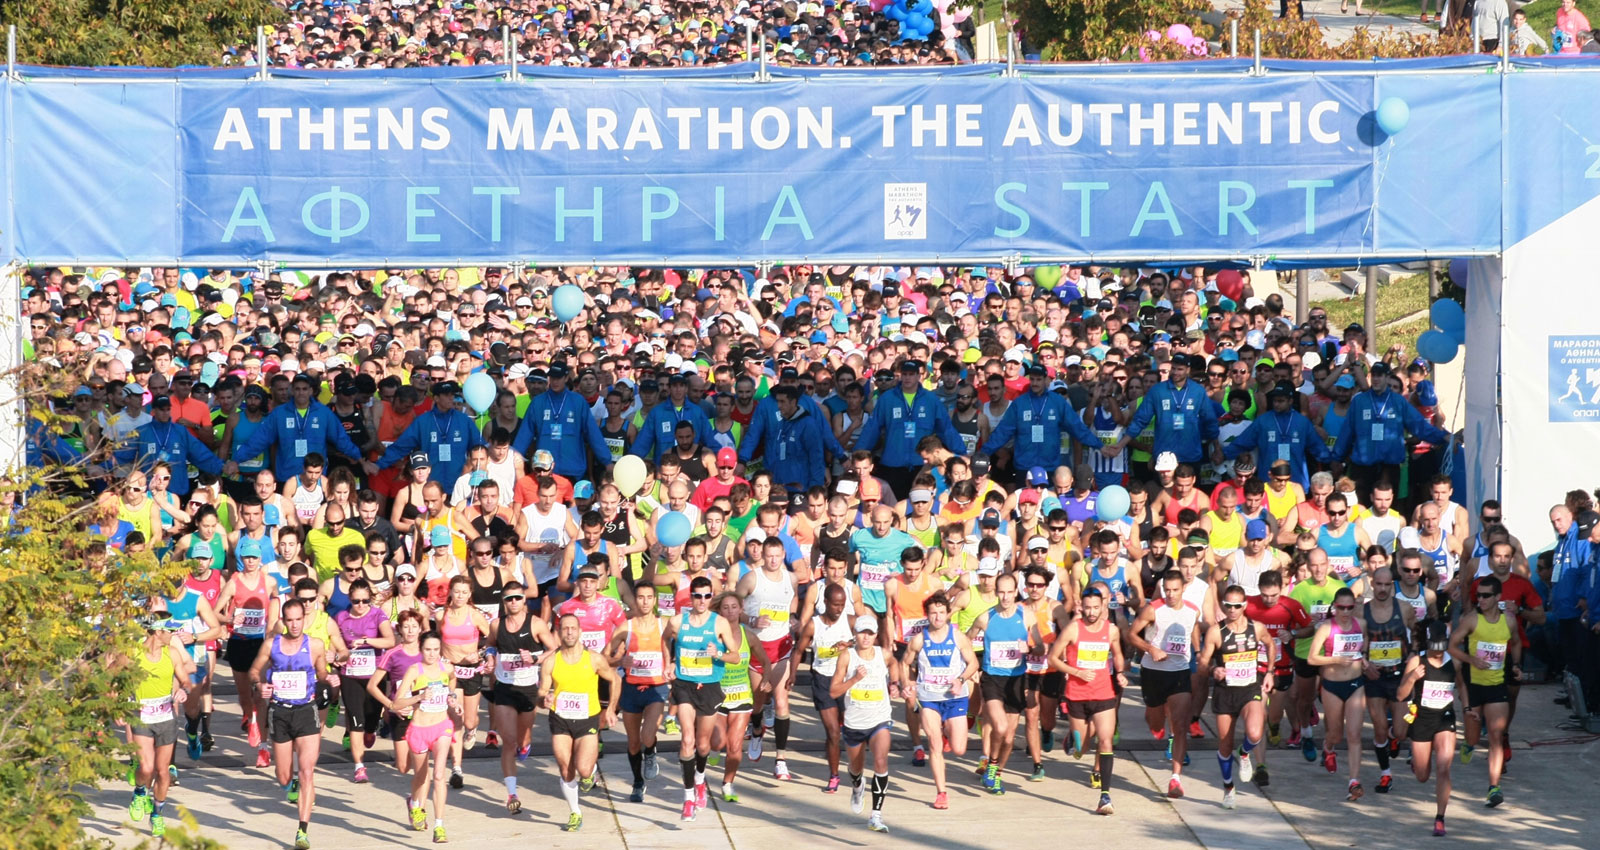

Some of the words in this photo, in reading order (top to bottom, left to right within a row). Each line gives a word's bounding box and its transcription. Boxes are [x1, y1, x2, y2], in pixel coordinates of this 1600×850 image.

[214, 107, 450, 151] ATHENS
[487, 107, 852, 150] MARATHON.
[872, 104, 983, 147] THE
[1003, 99, 1340, 147] AUTHENTIC
[994, 179, 1335, 237] START
[222, 185, 814, 243] ΑΦΕΤΗΡΙΑ
[867, 572, 882, 580] 322
[1344, 642, 1357, 650] 619
[1228, 653, 1255, 661] DHL
[1383, 649, 1389, 657] 9
[351, 657, 368, 665] 629
[692, 657, 698, 665] 4
[457, 668, 473, 676] 621
[933, 675, 949, 684] 275
[281, 680, 298, 689] 234
[728, 693, 741, 701] 101
[563, 701, 580, 709] 306
